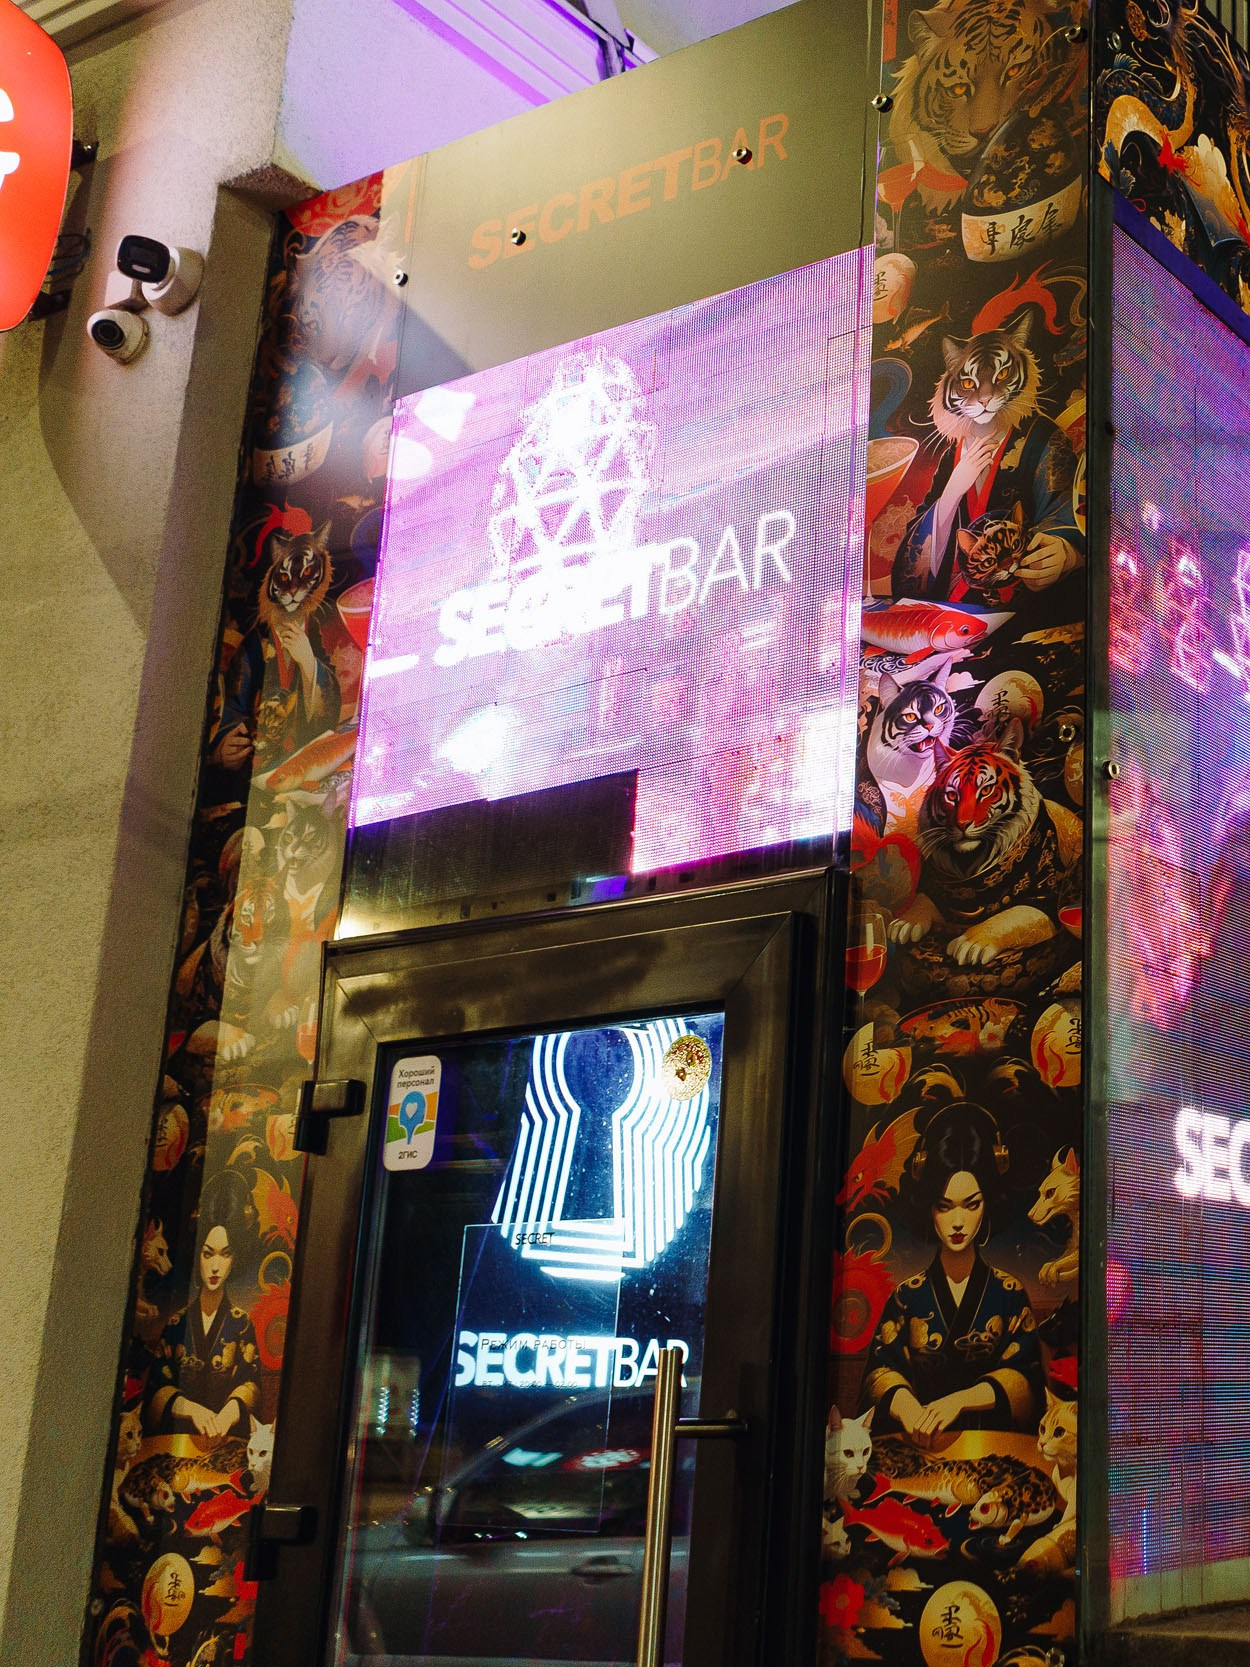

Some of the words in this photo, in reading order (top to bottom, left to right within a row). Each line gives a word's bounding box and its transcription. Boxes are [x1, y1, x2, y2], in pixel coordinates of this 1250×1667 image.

[468, 113, 789, 270] SECRETBAR
[398, 1066, 436, 1078] Хороший
[397, 1078, 434, 1089] персонал
[398, 1150, 418, 1160] 2ГИС
[515, 1232, 555, 1245] SECRET
